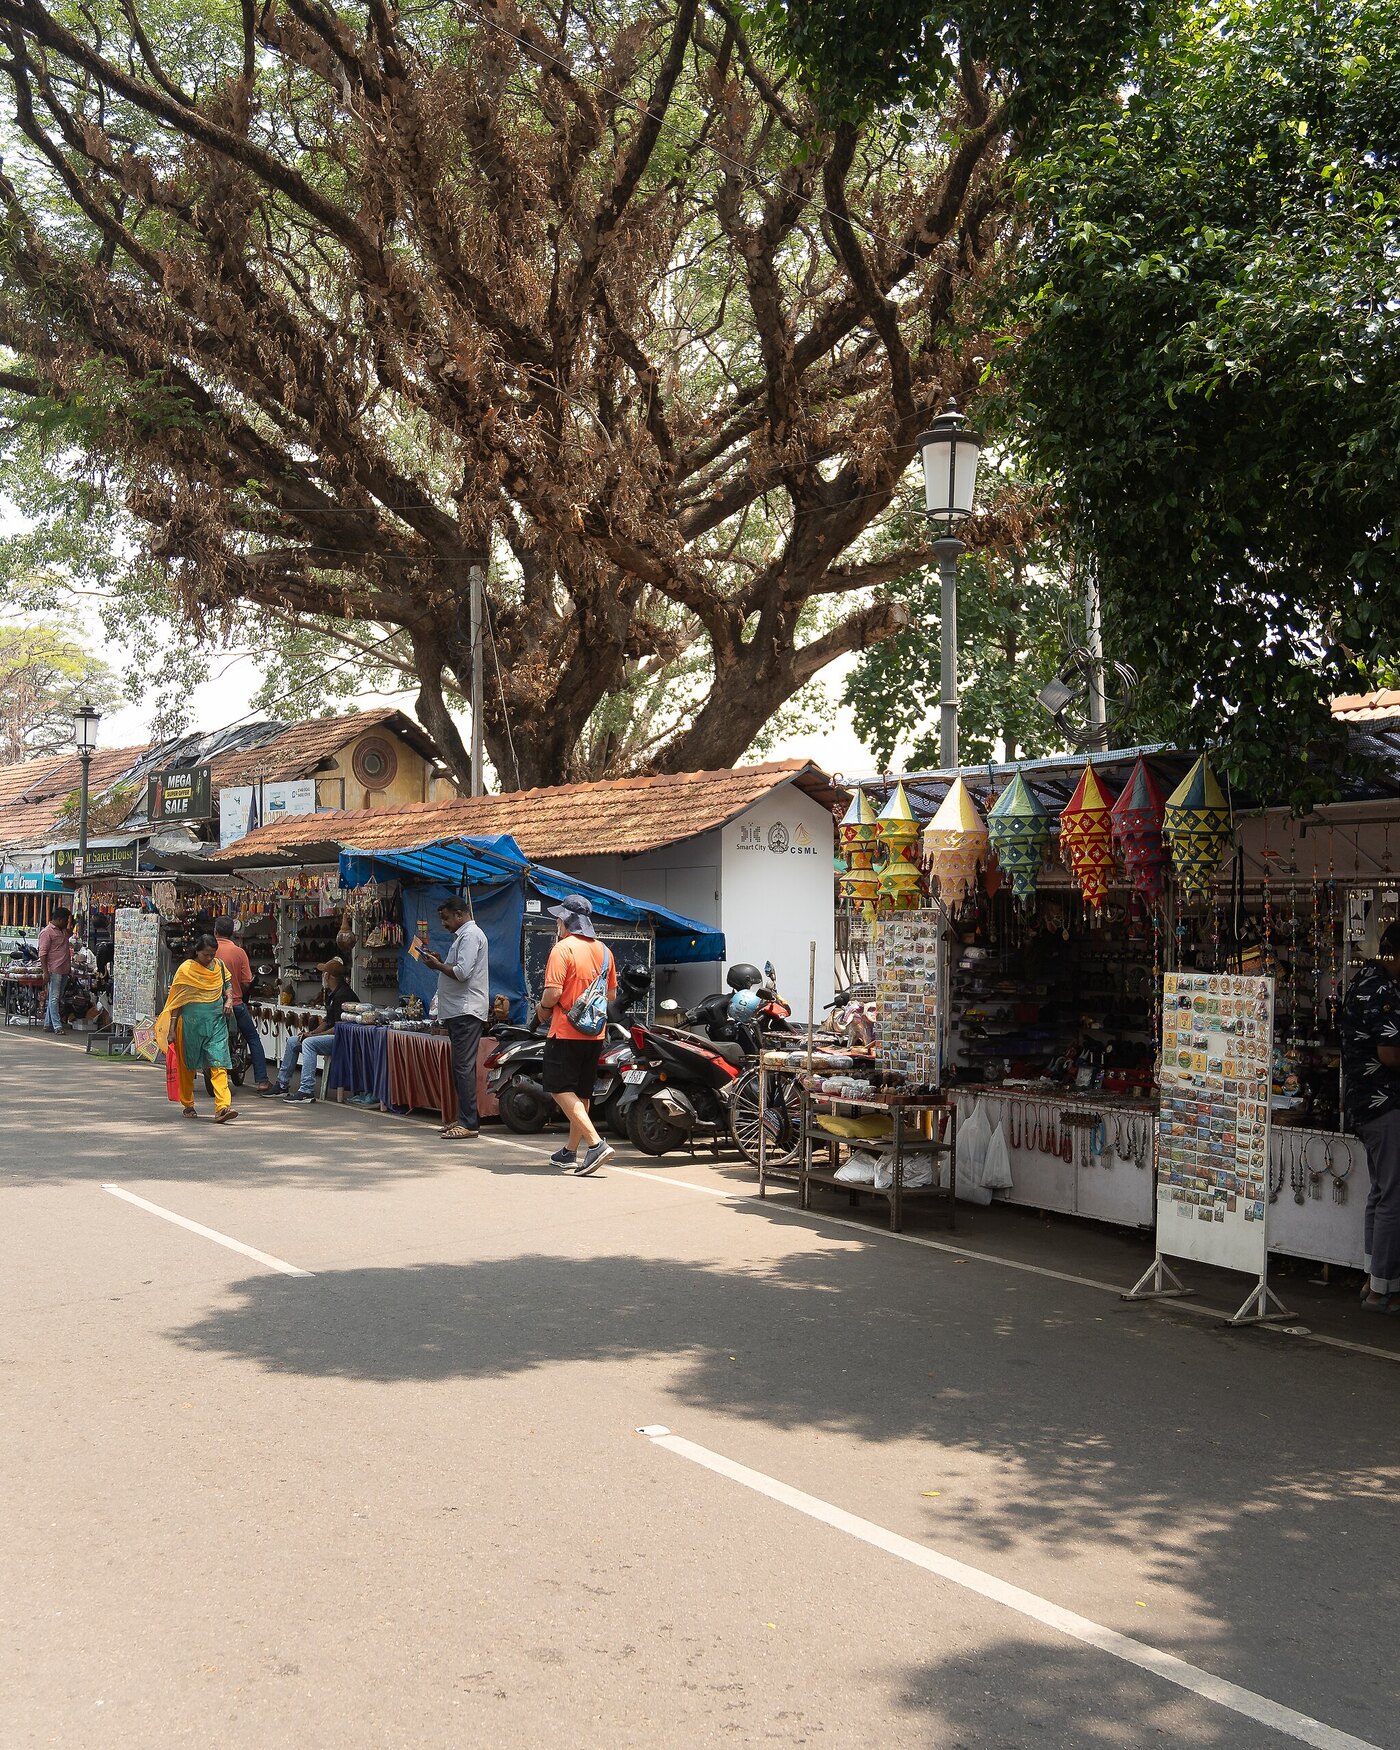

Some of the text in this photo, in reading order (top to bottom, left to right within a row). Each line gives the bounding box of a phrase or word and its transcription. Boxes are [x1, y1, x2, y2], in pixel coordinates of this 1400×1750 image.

[167, 773, 192, 788] MEGA
[164, 798, 189, 814] SALE
[736, 843, 767, 852] Smart City
[790, 846, 818, 855] CSML
[92, 849, 111, 862] Saree
[111, 848, 134, 860] House
[4, 875, 38, 889] Ice Cream
